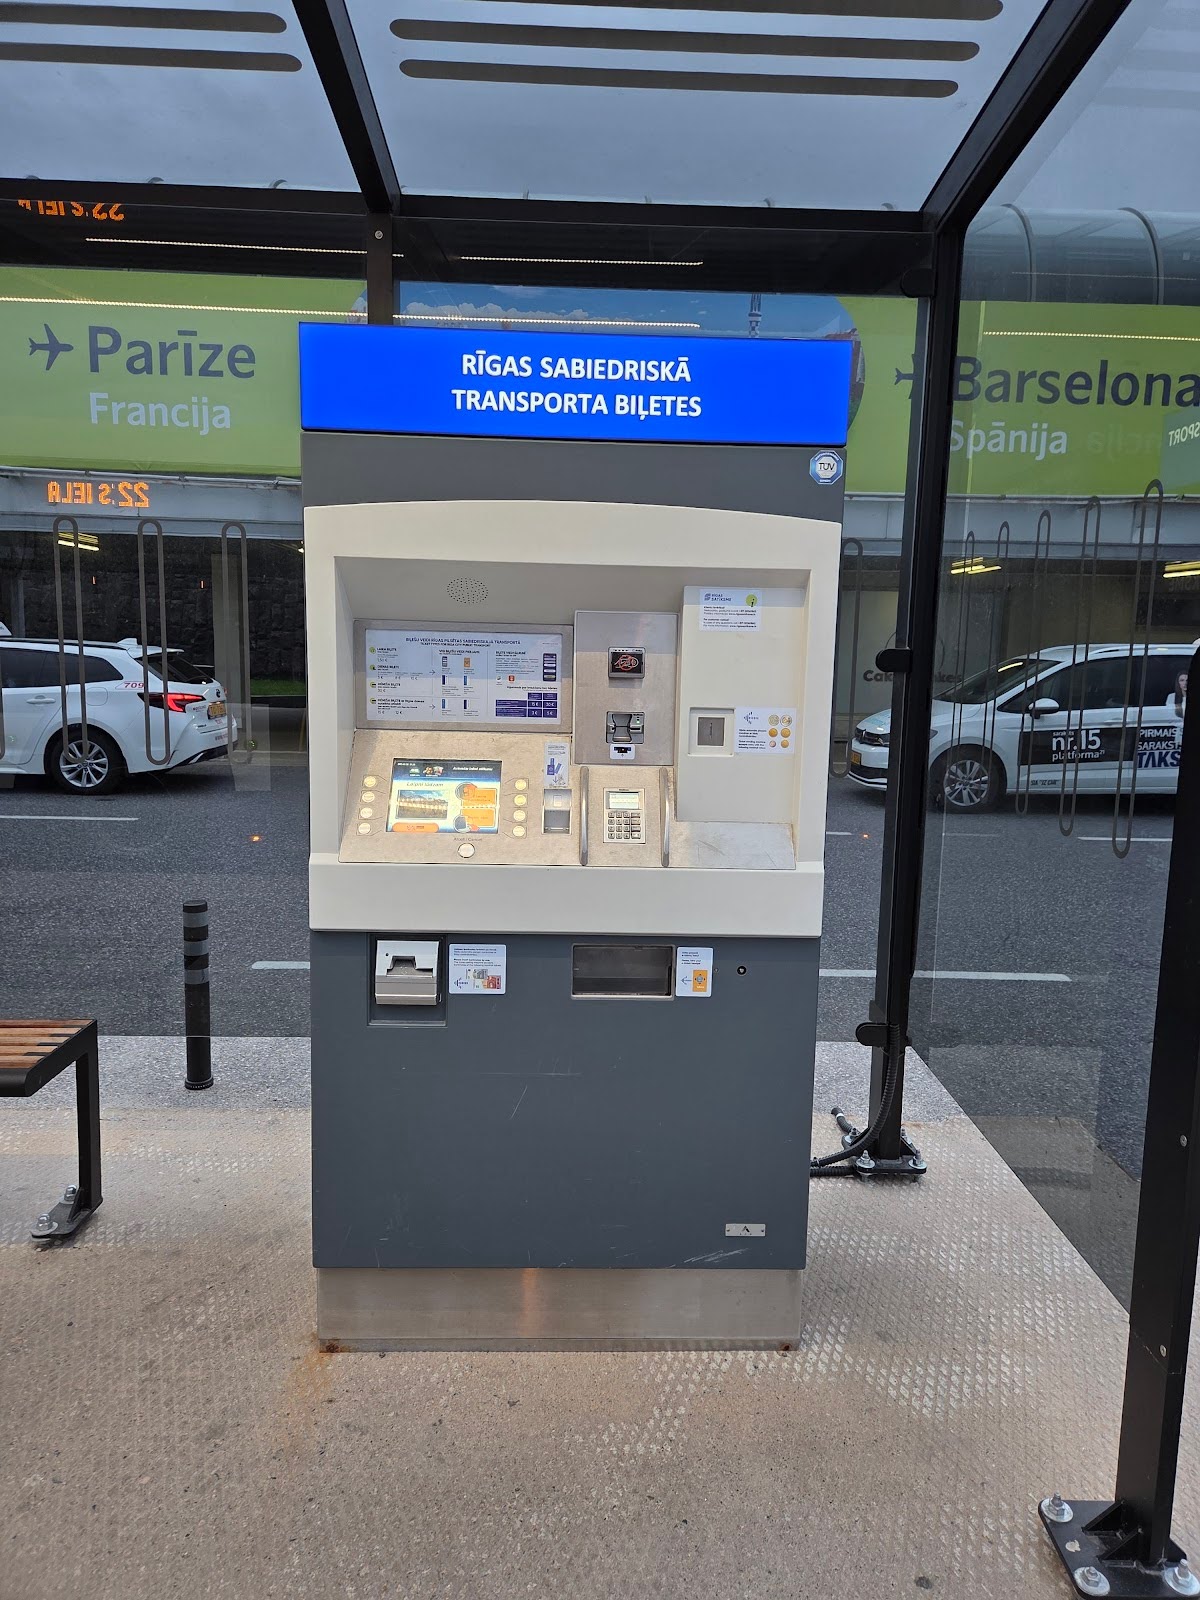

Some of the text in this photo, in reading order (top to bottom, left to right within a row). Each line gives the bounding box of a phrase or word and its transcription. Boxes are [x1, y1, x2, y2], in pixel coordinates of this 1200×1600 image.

[88, 325, 256, 379] Parīze
[461, 350, 692, 382] RĪGAS SABIEDRISKĀ
[953, 355, 1200, 407] Barselona
[90, 392, 231, 436] Francija
[451, 389, 702, 421] TRANSPORTA BIĻETES
[950, 419, 1068, 461] Spānija
